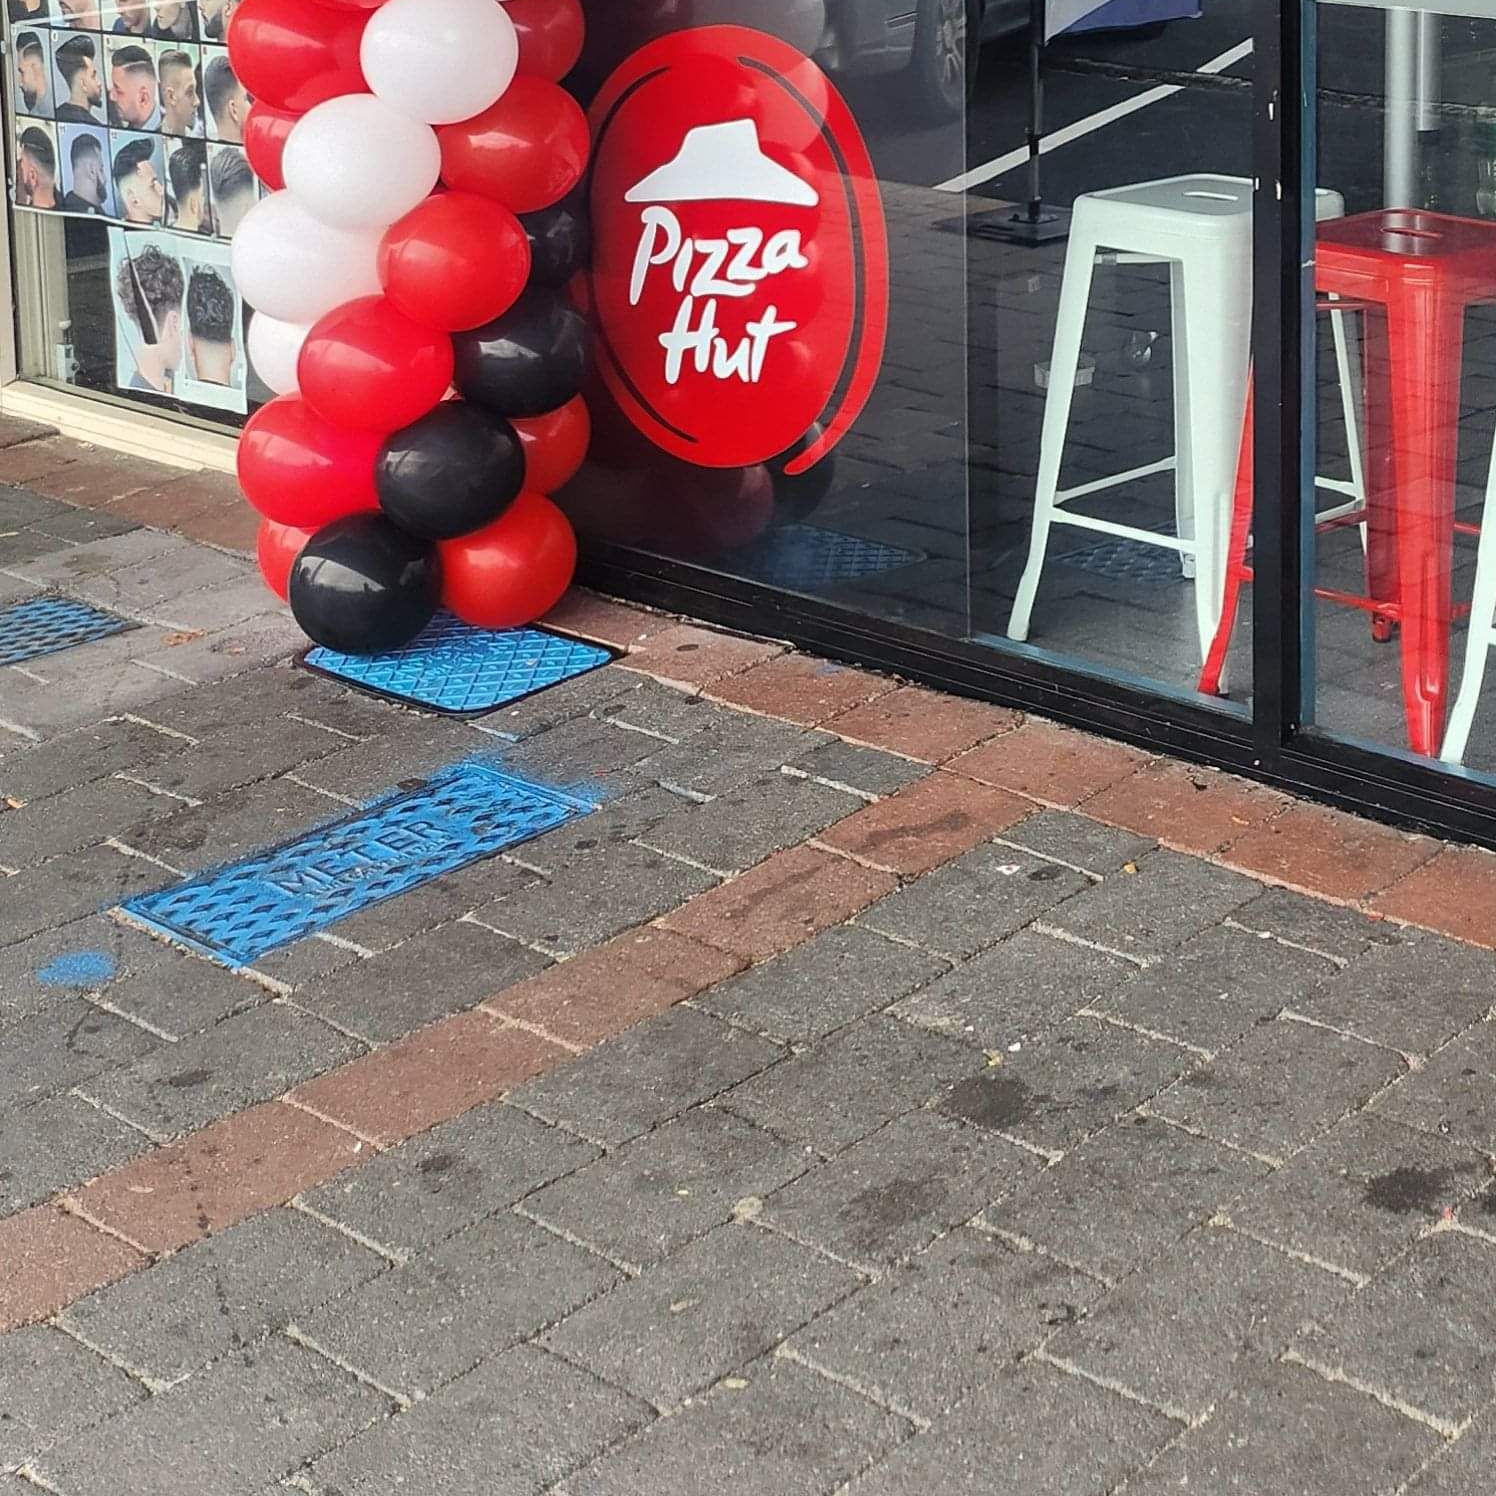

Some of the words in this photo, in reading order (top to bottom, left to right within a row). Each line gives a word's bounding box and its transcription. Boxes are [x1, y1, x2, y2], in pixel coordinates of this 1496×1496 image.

[629, 205, 809, 306] Pizza
[658, 294, 797, 385] Hut
[262, 820, 451, 900] METER
